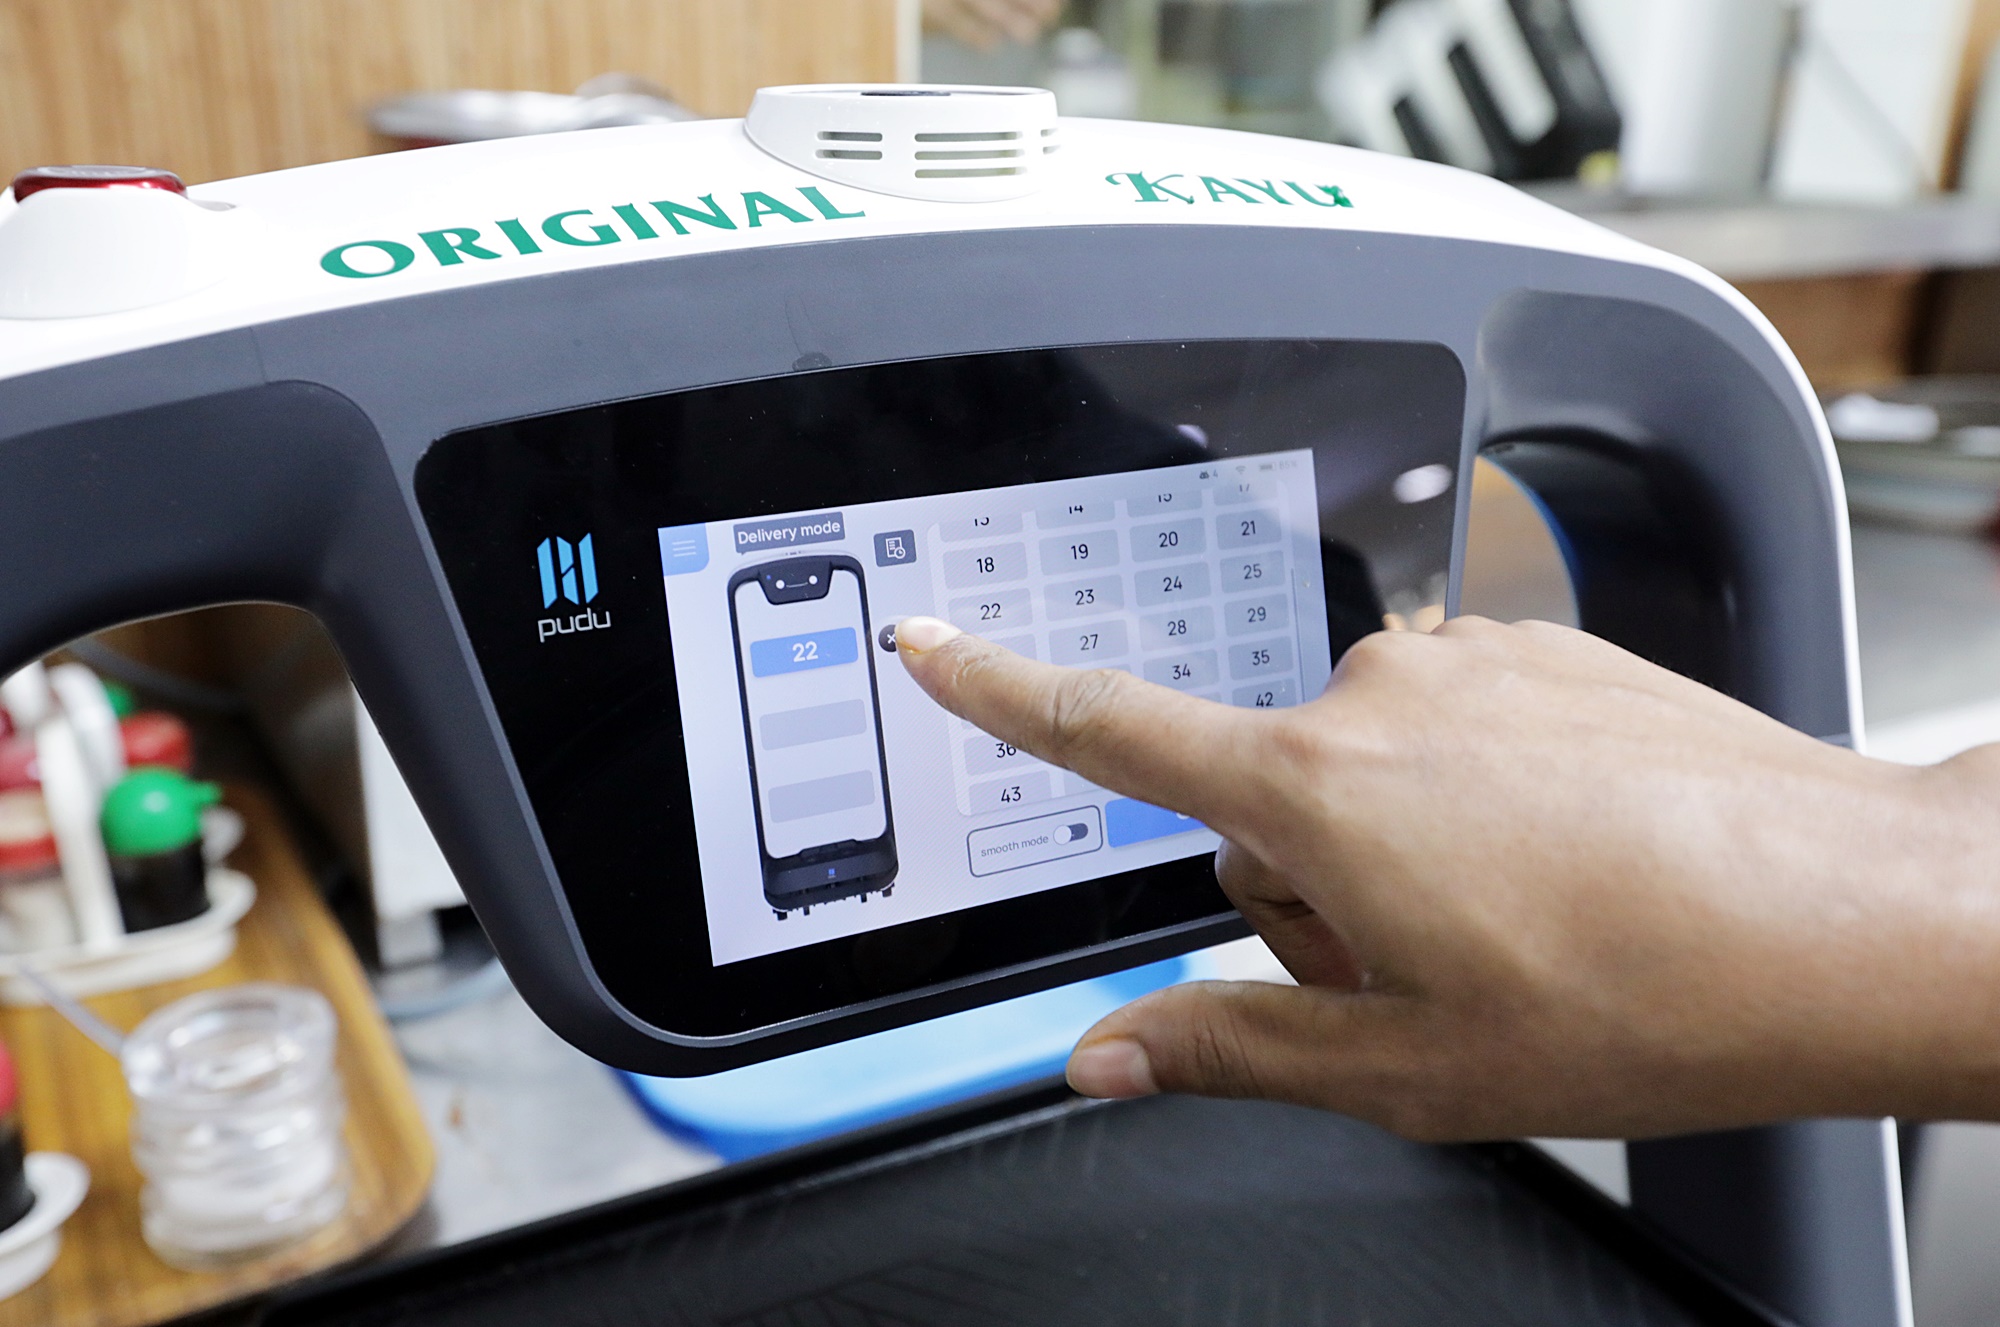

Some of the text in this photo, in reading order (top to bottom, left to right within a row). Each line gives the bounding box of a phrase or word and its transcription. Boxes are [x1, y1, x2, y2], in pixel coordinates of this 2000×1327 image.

[320, 171, 1354, 278] ORIGINAL KAYU
[738, 520, 840, 545] Delivery mode
[1241, 520, 1256, 536] 21
[1158, 531, 1179, 548] 20
[1070, 543, 1089, 560] 19
[976, 556, 995, 574] 18
[1243, 564, 1262, 580] 25
[1163, 576, 1183, 592] 24
[1074, 589, 1095, 606] 23
[980, 603, 1002, 621] 22
[1247, 606, 1266, 622] 29
[537, 607, 612, 643] pudu
[1168, 619, 1187, 637] 28
[1080, 633, 1099, 651] 27
[792, 641, 819, 663] 22
[1252, 649, 1270, 666] 35
[1172, 663, 1192, 680] 34
[1255, 691, 1274, 708] 42
[995, 742, 1017, 758] 36
[1001, 785, 1021, 803] 43
[981, 836, 1049, 857] smooth mode
